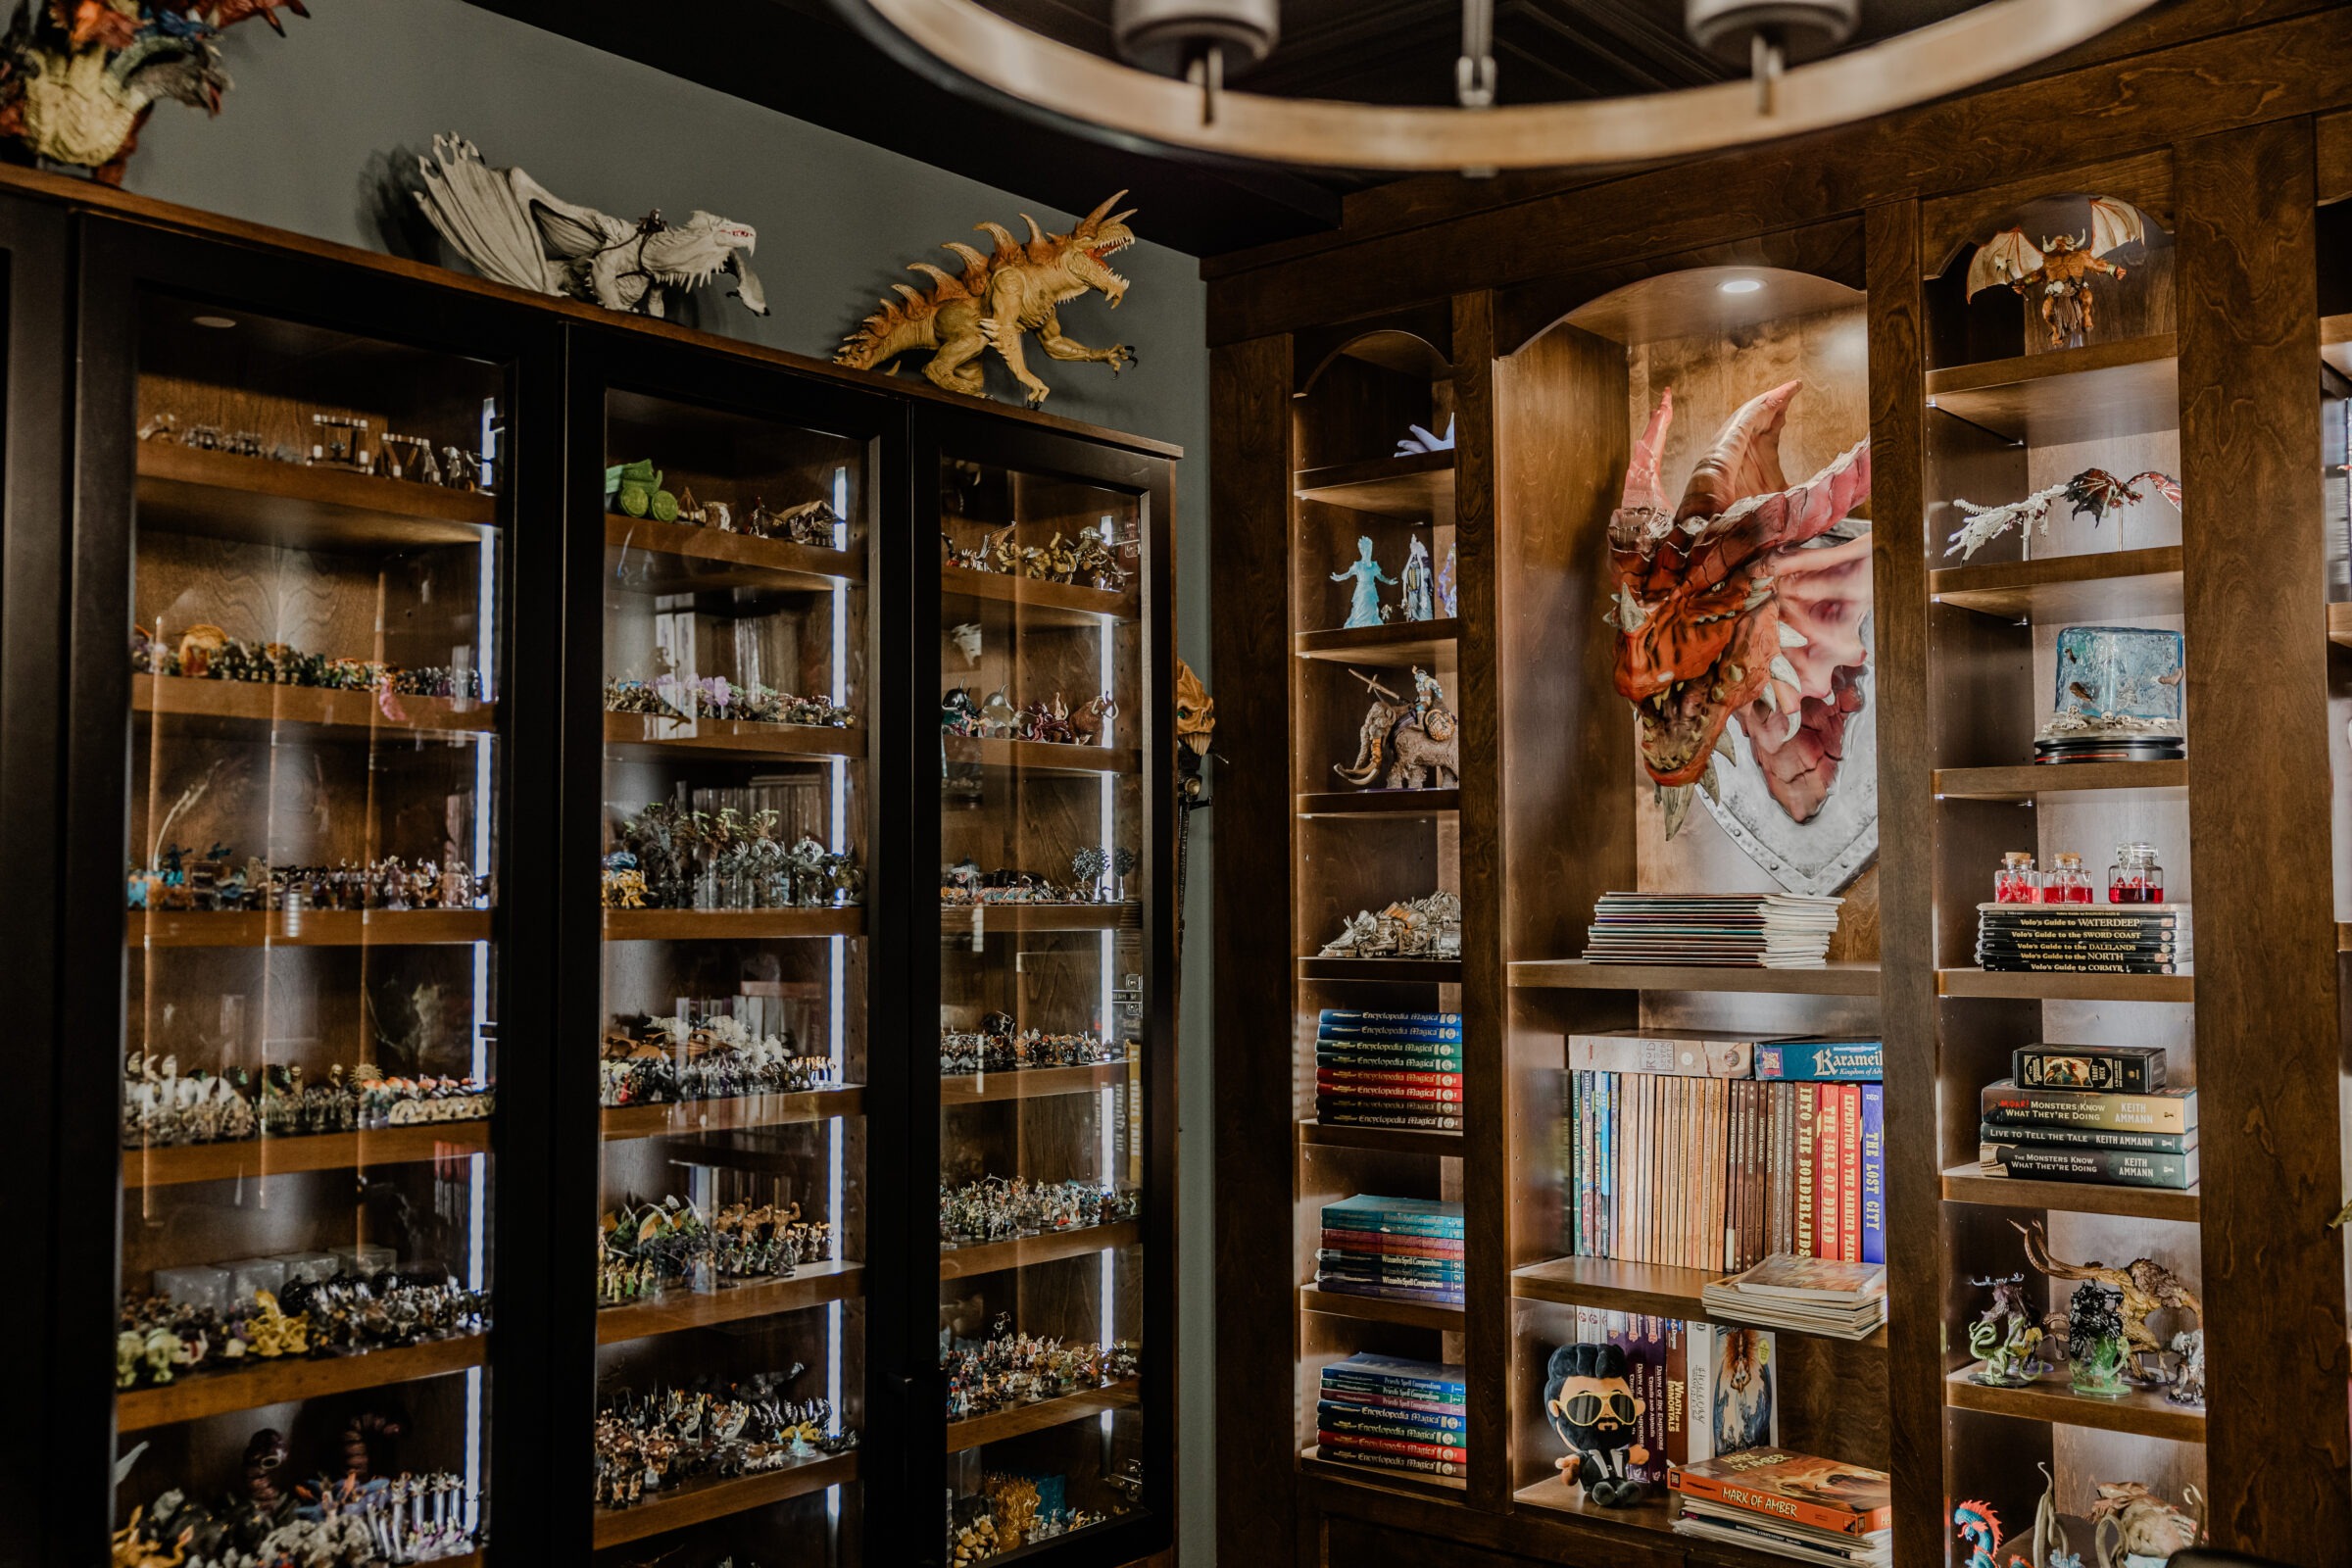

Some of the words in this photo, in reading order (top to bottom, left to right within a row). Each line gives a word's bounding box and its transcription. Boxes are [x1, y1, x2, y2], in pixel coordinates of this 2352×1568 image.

[1361, 1026, 1407, 1035] Encyclopedia
[1356, 1043, 1403, 1052] Encyclopedia
[1357, 1057, 1403, 1066] Encyclopedia
[1357, 1072, 1404, 1082] Encyclopedia
[1357, 1087, 1404, 1096] Encyclopedia
[1800, 1088, 1812, 1120] INTO
[2031, 1102, 2077, 1110] MONSTERS
[2080, 1102, 2106, 1112] KNOW
[2121, 1102, 2146, 1113] KEITH
[1359, 1116, 1406, 1125] Encyclopedia
[1824, 1105, 1836, 1133] THE
[2005, 1108, 2031, 1117] WHAT
[2033, 1110, 2070, 1119] THEY'RE
[2072, 1111, 2101, 1121] DOING
[2115, 1113, 2153, 1124] AMMANN
[1843, 1095, 1855, 1150] EXPEDITION
[1799, 1126, 1812, 1153] THE
[1866, 1133, 1879, 1156] THE
[1989, 1129, 2009, 1138] LIVE
[2025, 1131, 2046, 1141] TELL
[2066, 1133, 2087, 1143] TALE
[2096, 1135, 2118, 1144] KEITH
[2119, 1136, 2154, 1147] AMMANN
[1824, 1139, 1835, 1169] ISLE
[1844, 1152, 1855, 1165] TO
[2026, 1153, 2068, 1163] MONSTERS
[2070, 1155, 2094, 1165] KNOW
[2034, 1161, 2070, 1171] THEY'RE
[2072, 1163, 2097, 1173] DOING
[2124, 1157, 2148, 1167] KEITH
[1844, 1168, 1854, 1187] THE
[2119, 1166, 2154, 1177] AMMANN
[1824, 1175, 1835, 1192] OF
[1866, 1163, 1879, 1195] LOST
[1798, 1159, 1811, 1256] BORDERLANDS
[1844, 1190, 1854, 1231] BARRIER
[1823, 1198, 1835, 1244] DREAD
[1866, 1201, 1879, 1230] CITY
[1844, 1234, 1854, 1262] PEAKS
[1402, 1256, 1412, 1266] Spell
[1413, 1258, 1442, 1267] Compendium
[1402, 1278, 1413, 1287] Spell
[1414, 1279, 1443, 1289] Compendium
[1412, 1380, 1441, 1390] Compendium
[1399, 1389, 1410, 1397] Spell
[1411, 1390, 1440, 1399] Compendium
[1675, 1381, 1684, 1414] WRATH
[1667, 1381, 1676, 1432] IMMORTALS
[1361, 1407, 1408, 1420] Encyclopedia
[1357, 1423, 1405, 1436] Encyclopedia
[1358, 1453, 1404, 1466] Encyclopedia
[1720, 1452, 1759, 1464] MARK
[1748, 1454, 1793, 1467] AMBER
[1723, 1487, 1748, 1503] MARK
[1750, 1495, 1763, 1507] OF
[1765, 1498, 1796, 1516] AMBER
